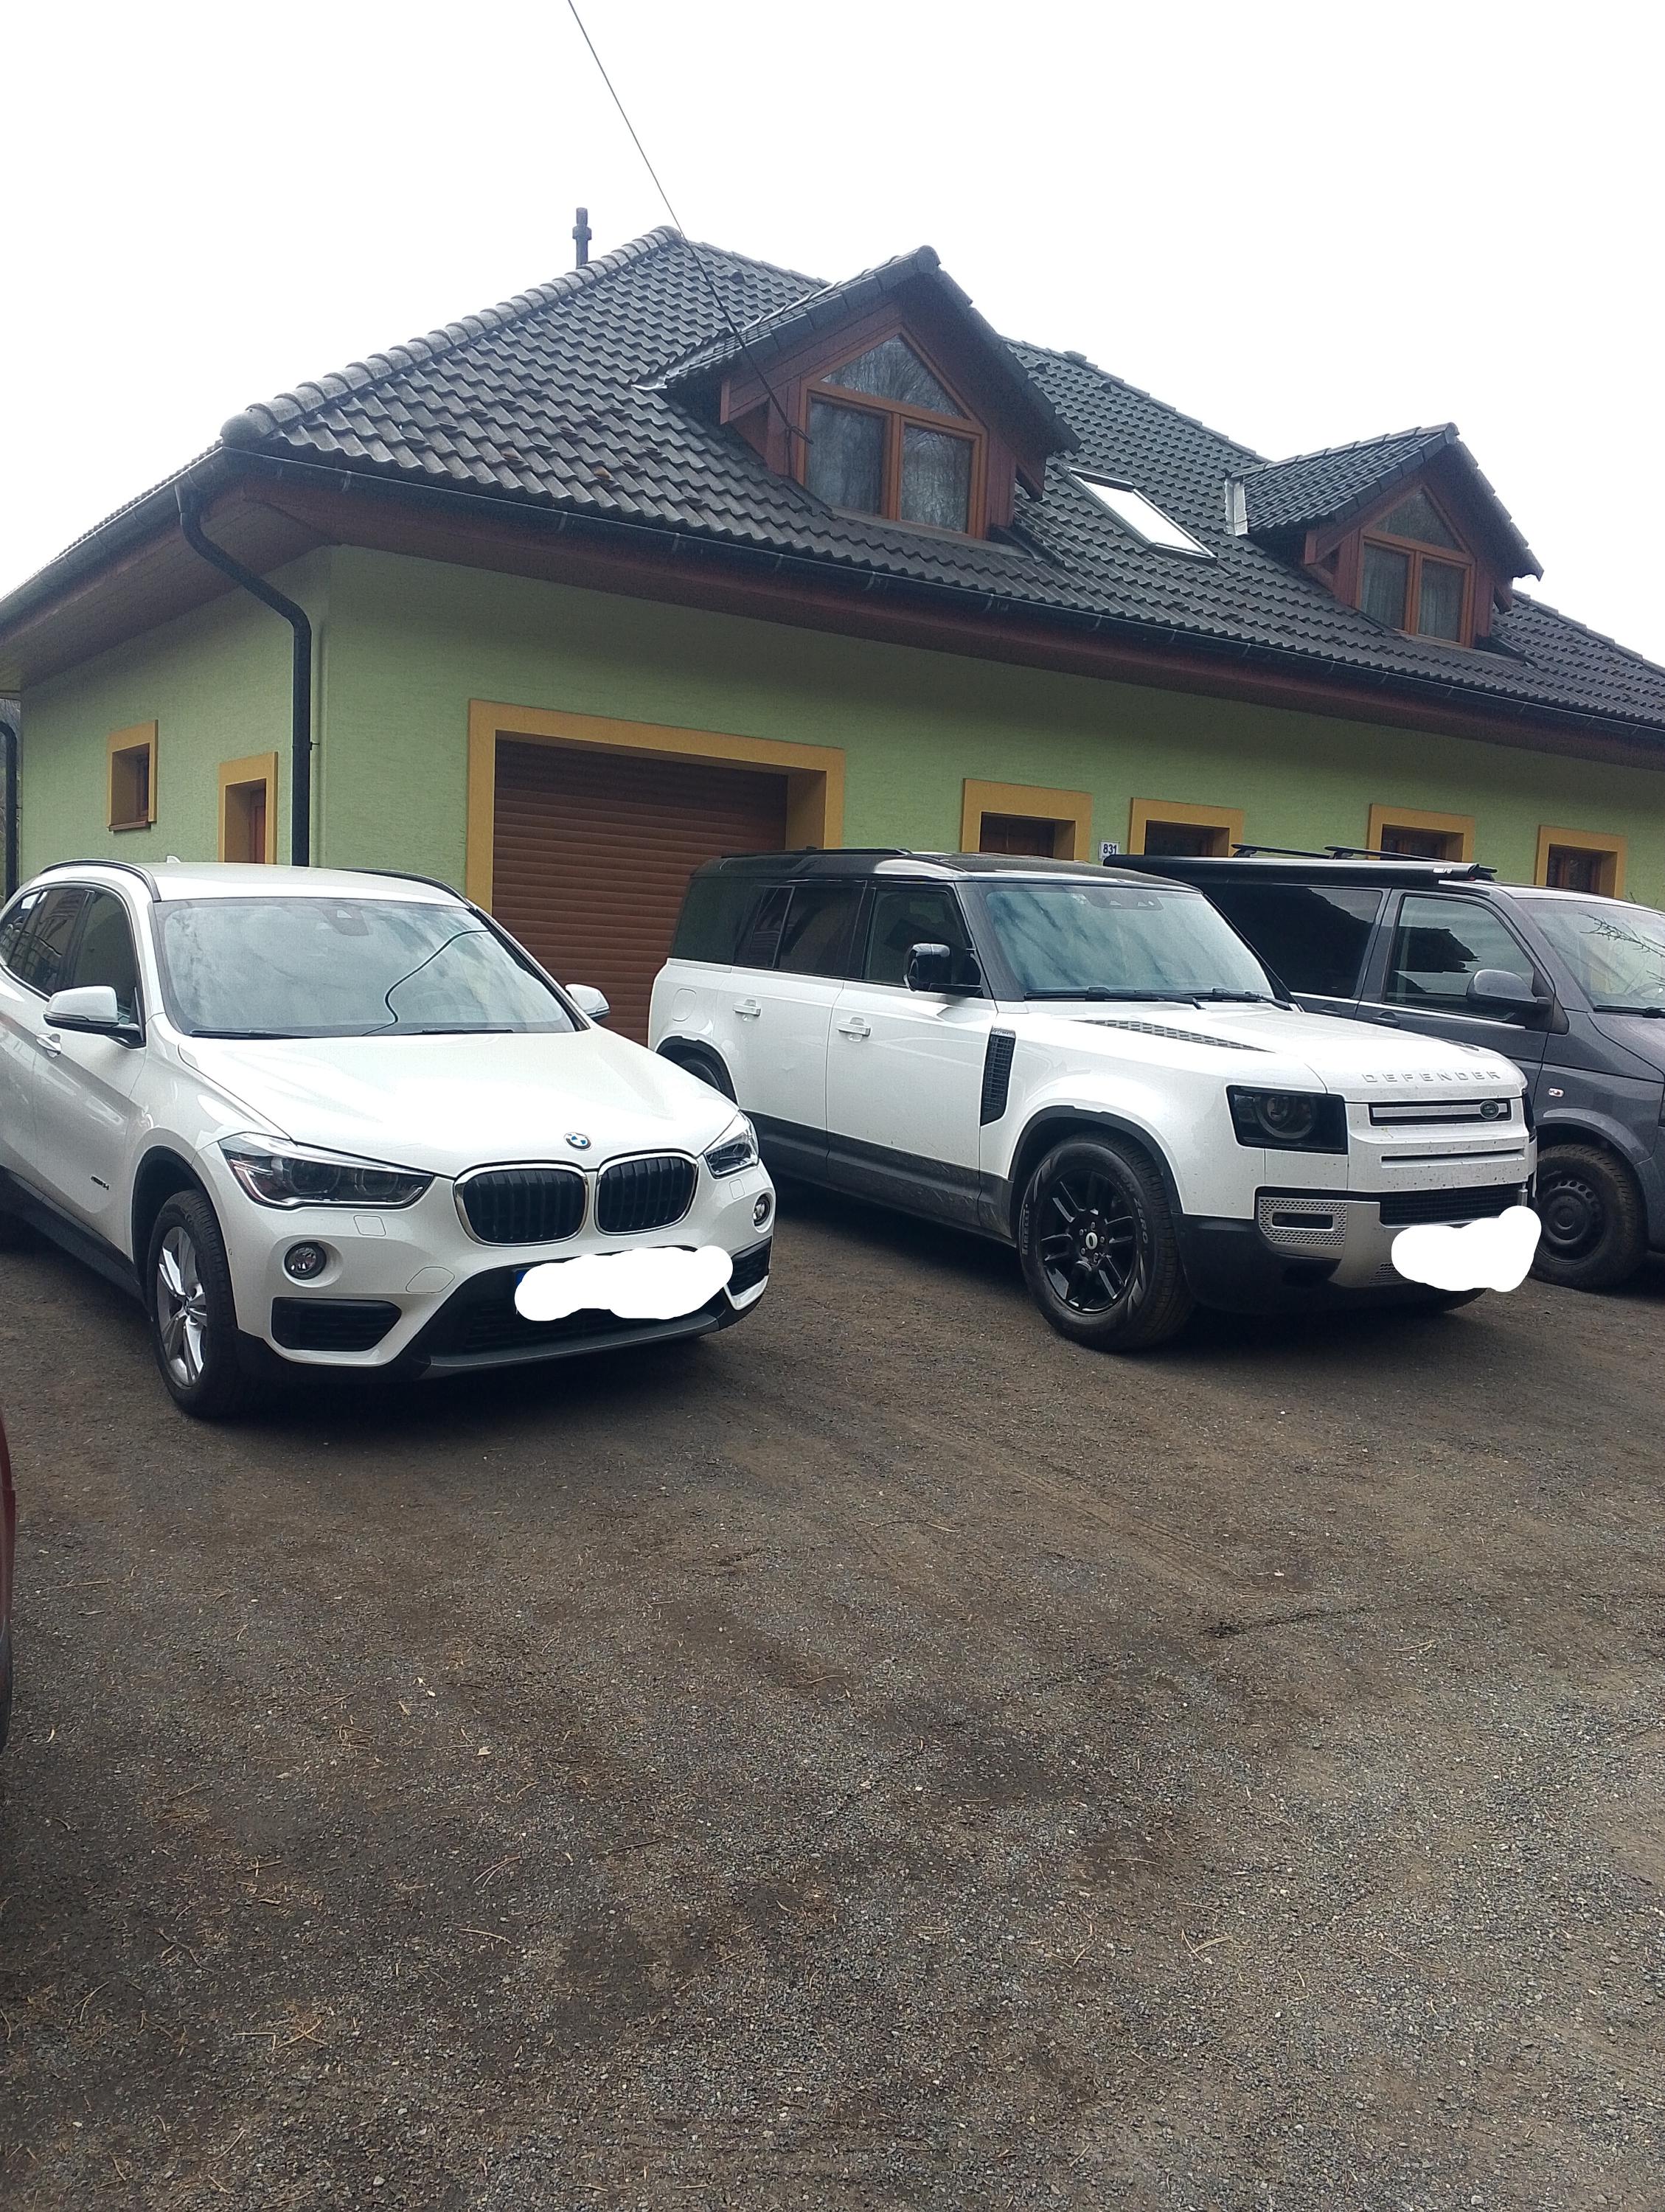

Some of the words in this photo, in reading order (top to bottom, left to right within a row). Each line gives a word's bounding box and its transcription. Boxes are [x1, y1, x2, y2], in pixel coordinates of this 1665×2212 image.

[1103, 844, 1117, 855] 831
[1362, 1071, 1501, 1083] DEFENDER
[1133, 1197, 1148, 1244] ZERO
